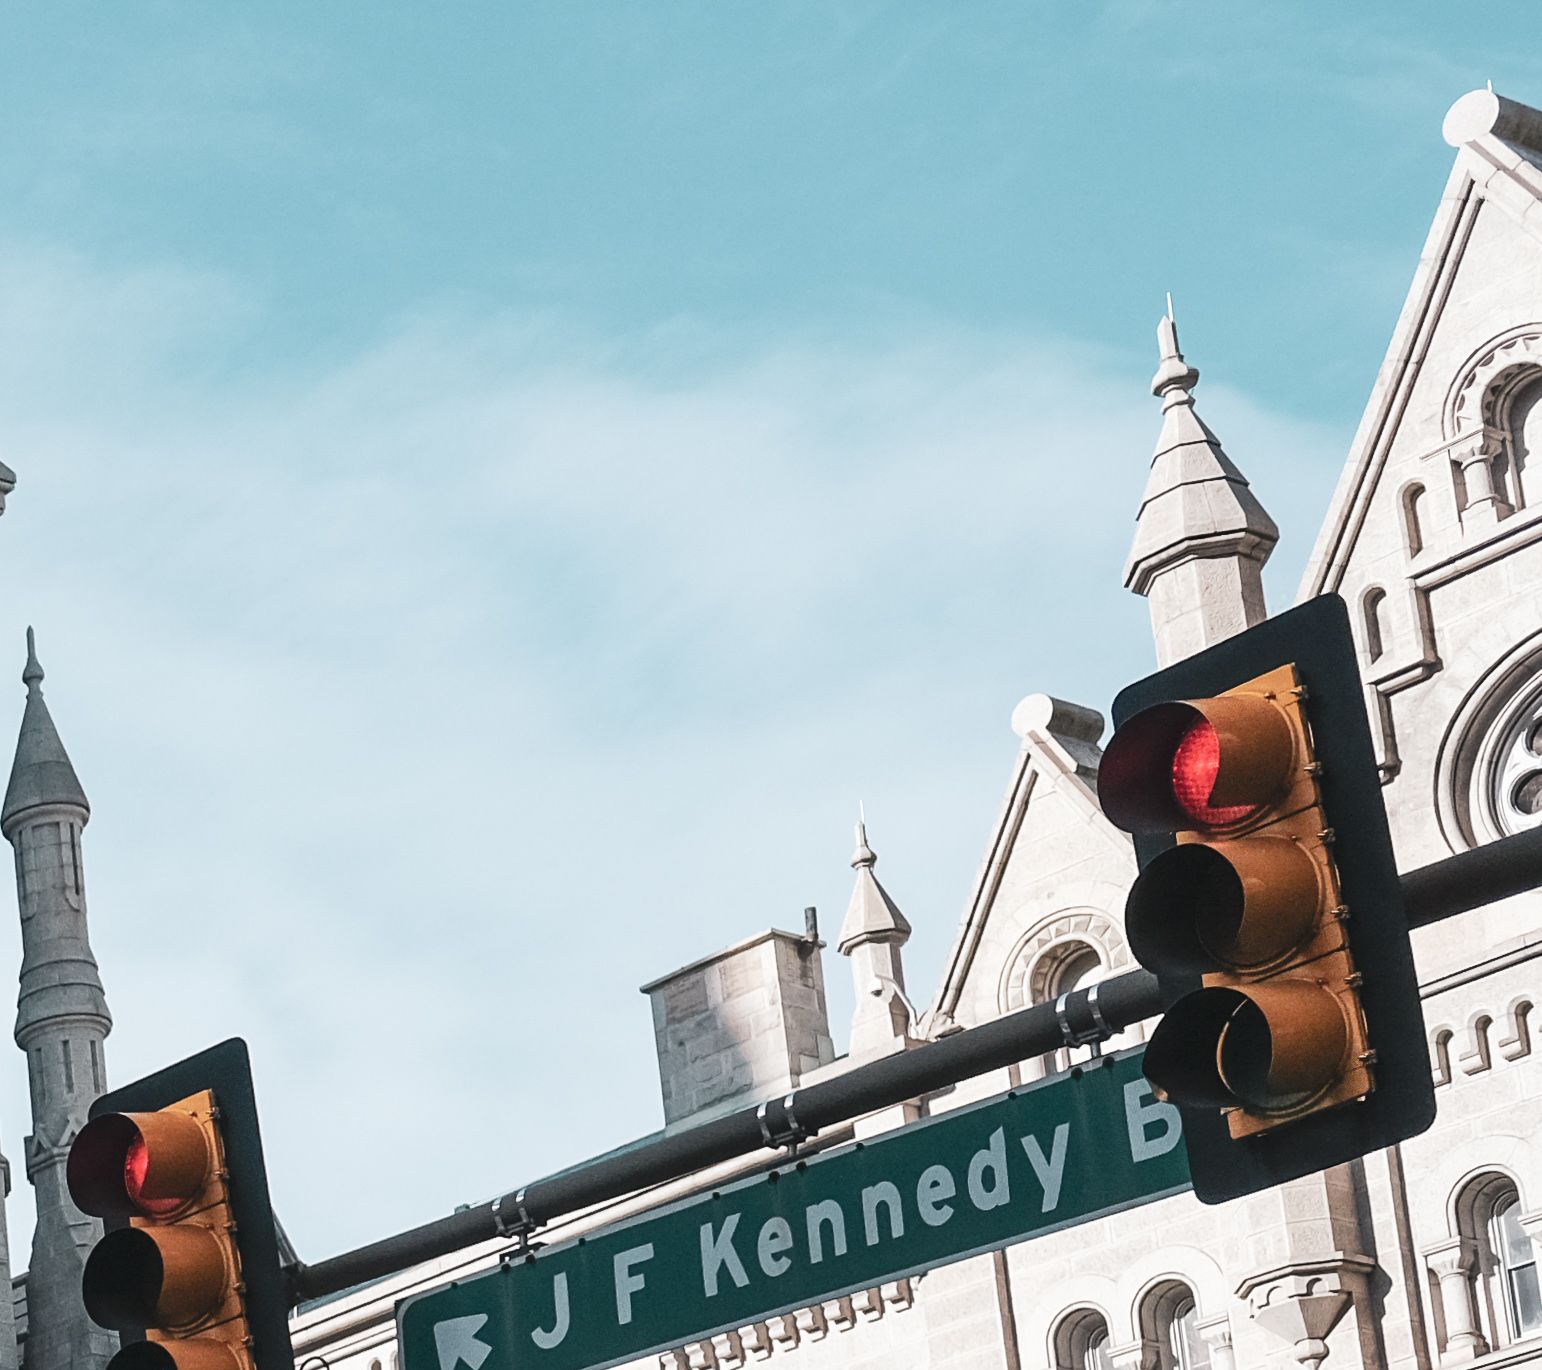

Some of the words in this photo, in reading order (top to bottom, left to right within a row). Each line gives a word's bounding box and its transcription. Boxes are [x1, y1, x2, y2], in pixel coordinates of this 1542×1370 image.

[531, 1272, 569, 1350] J
[613, 1243, 655, 1325] F
[699, 1123, 1070, 1298] Kennedy
